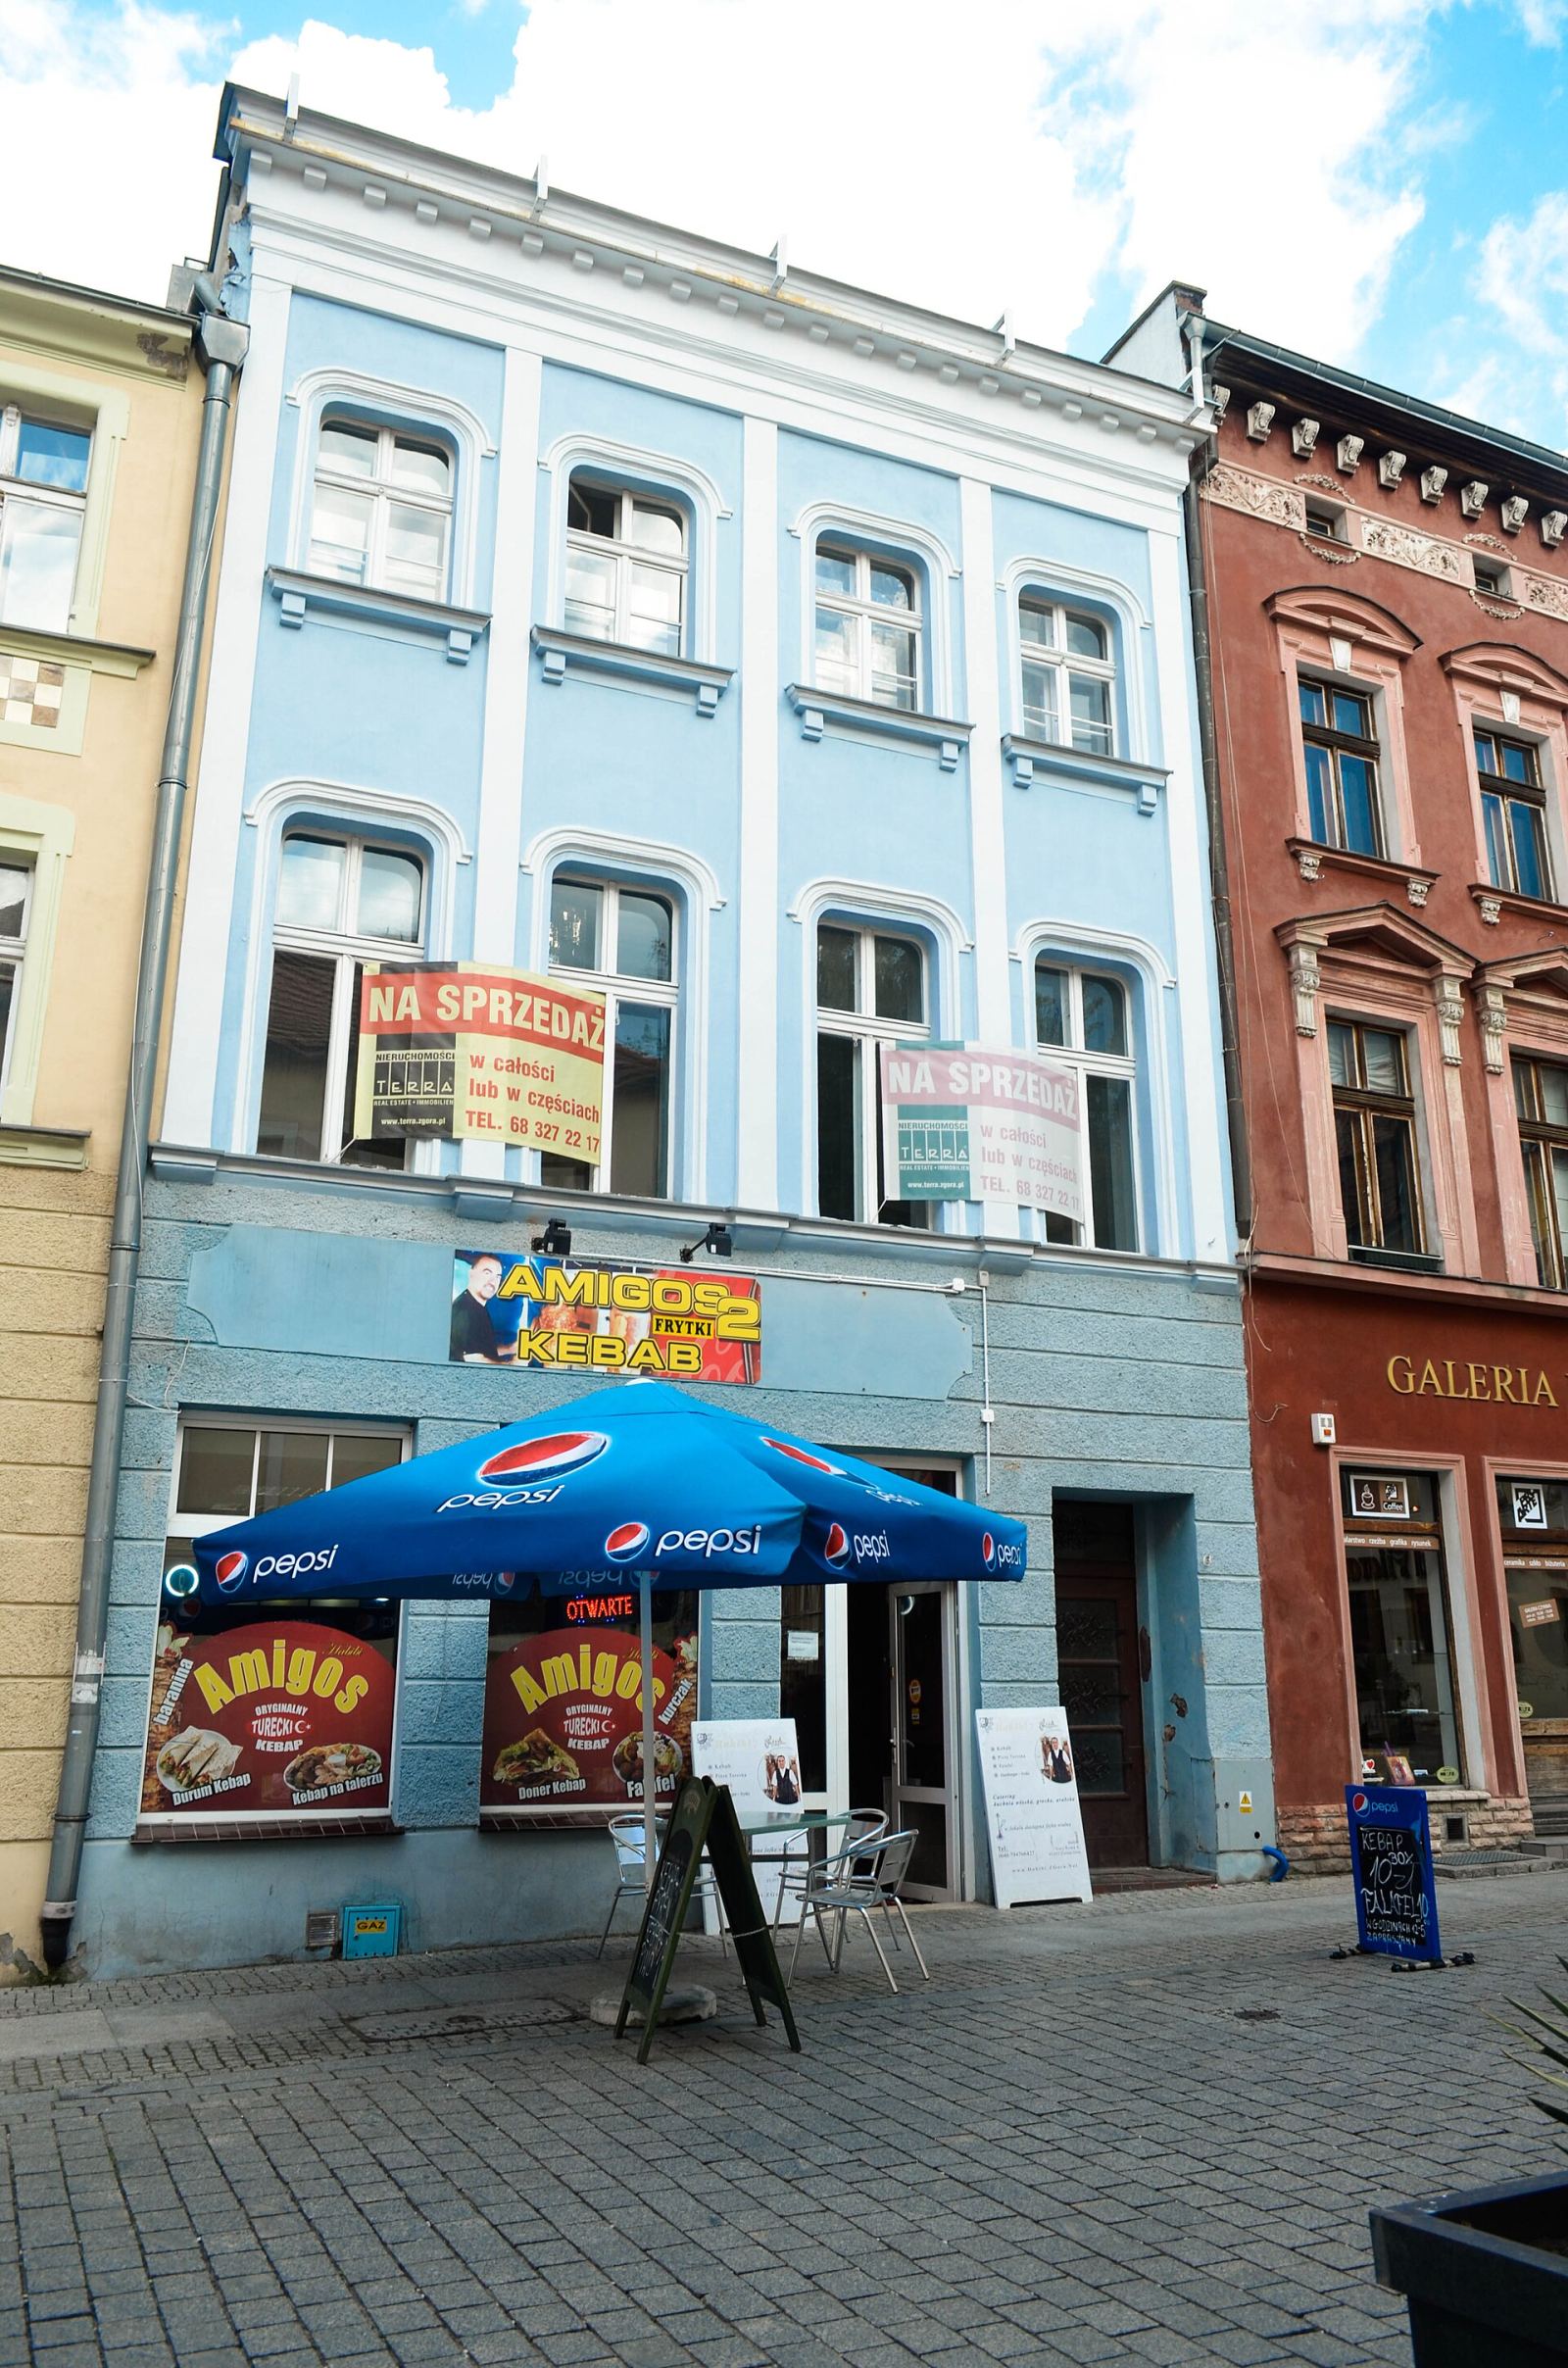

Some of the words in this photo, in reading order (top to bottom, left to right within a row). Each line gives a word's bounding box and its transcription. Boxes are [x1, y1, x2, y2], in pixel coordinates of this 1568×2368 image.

[368, 985, 421, 1022] NA
[436, 984, 605, 1053] SPRZEDAŻ
[375, 1051, 455, 1061] NIERUCHOMOŚCI
[469, 1055, 484, 1069] w
[493, 1056, 555, 1083] całości
[376, 1080, 453, 1093] TERRA
[889, 1061, 936, 1094] NA
[949, 1061, 1077, 1120] SPRZEDAŻ
[468, 1078, 498, 1099] lub
[507, 1087, 520, 1102] w
[527, 1090, 600, 1124] częściach
[381, 1117, 446, 1126] www.terra.zgora.pl
[466, 1110, 503, 1130] TEL.
[510, 1115, 529, 1135] 68
[534, 1121, 560, 1142] 327
[564, 1128, 581, 1148] 22
[586, 1135, 600, 1154] 17
[980, 1125, 993, 1138] w
[1000, 1126, 1047, 1148] całości
[901, 1147, 968, 1159] TERRA
[981, 1147, 1005, 1164] lub
[1011, 1154, 1023, 1165] w
[980, 1175, 1010, 1193] TEL.
[1016, 1180, 1030, 1197] 68
[1036, 1184, 1054, 1200] 327
[497, 1264, 731, 1316] AMIGOS
[715, 1296, 760, 1342] 2
[655, 1317, 712, 1337] FRYTKI
[516, 1329, 702, 1373] KEBAB
[1387, 1355, 1559, 1407] GALERIA
[436, 1484, 565, 1513] pepsi
[1383, 1502, 1403, 1511] Coffee
[655, 1525, 761, 1557] pepsi
[854, 1529, 891, 1563] pepsi
[252, 1544, 339, 1583] pepsi
[997, 1542, 1022, 1568] pepsi
[566, 1595, 633, 1620] OTWARTE
[193, 1639, 369, 1714] Amigos
[510, 1644, 665, 1715] Amigos
[153, 1657, 195, 1726] baranina
[658, 1679, 694, 1726] kurczak
[255, 1702, 309, 1716] ORYGINALNY
[565, 1703, 613, 1716] ORYGINALNY
[251, 1716, 293, 1738] TURECKI
[564, 1716, 600, 1737] TURECKI
[255, 1739, 304, 1752] KEBAP
[567, 1738, 610, 1751] KEBAP
[172, 1785, 214, 1806] Durum
[214, 1772, 251, 1793] Kebap
[292, 1784, 328, 1806] Kebap
[329, 1783, 345, 1797] na
[344, 1771, 384, 1793] talerzu
[518, 1782, 552, 1801] Doner
[553, 1777, 587, 1797] Kebap
[626, 1773, 676, 1799] Fafel
[1371, 1801, 1398, 1813] pepsi
[1361, 1831, 1403, 1851] KEBAP
[1360, 1888, 1420, 1918] FALAFEL
[357, 1921, 385, 1931] GAZ
